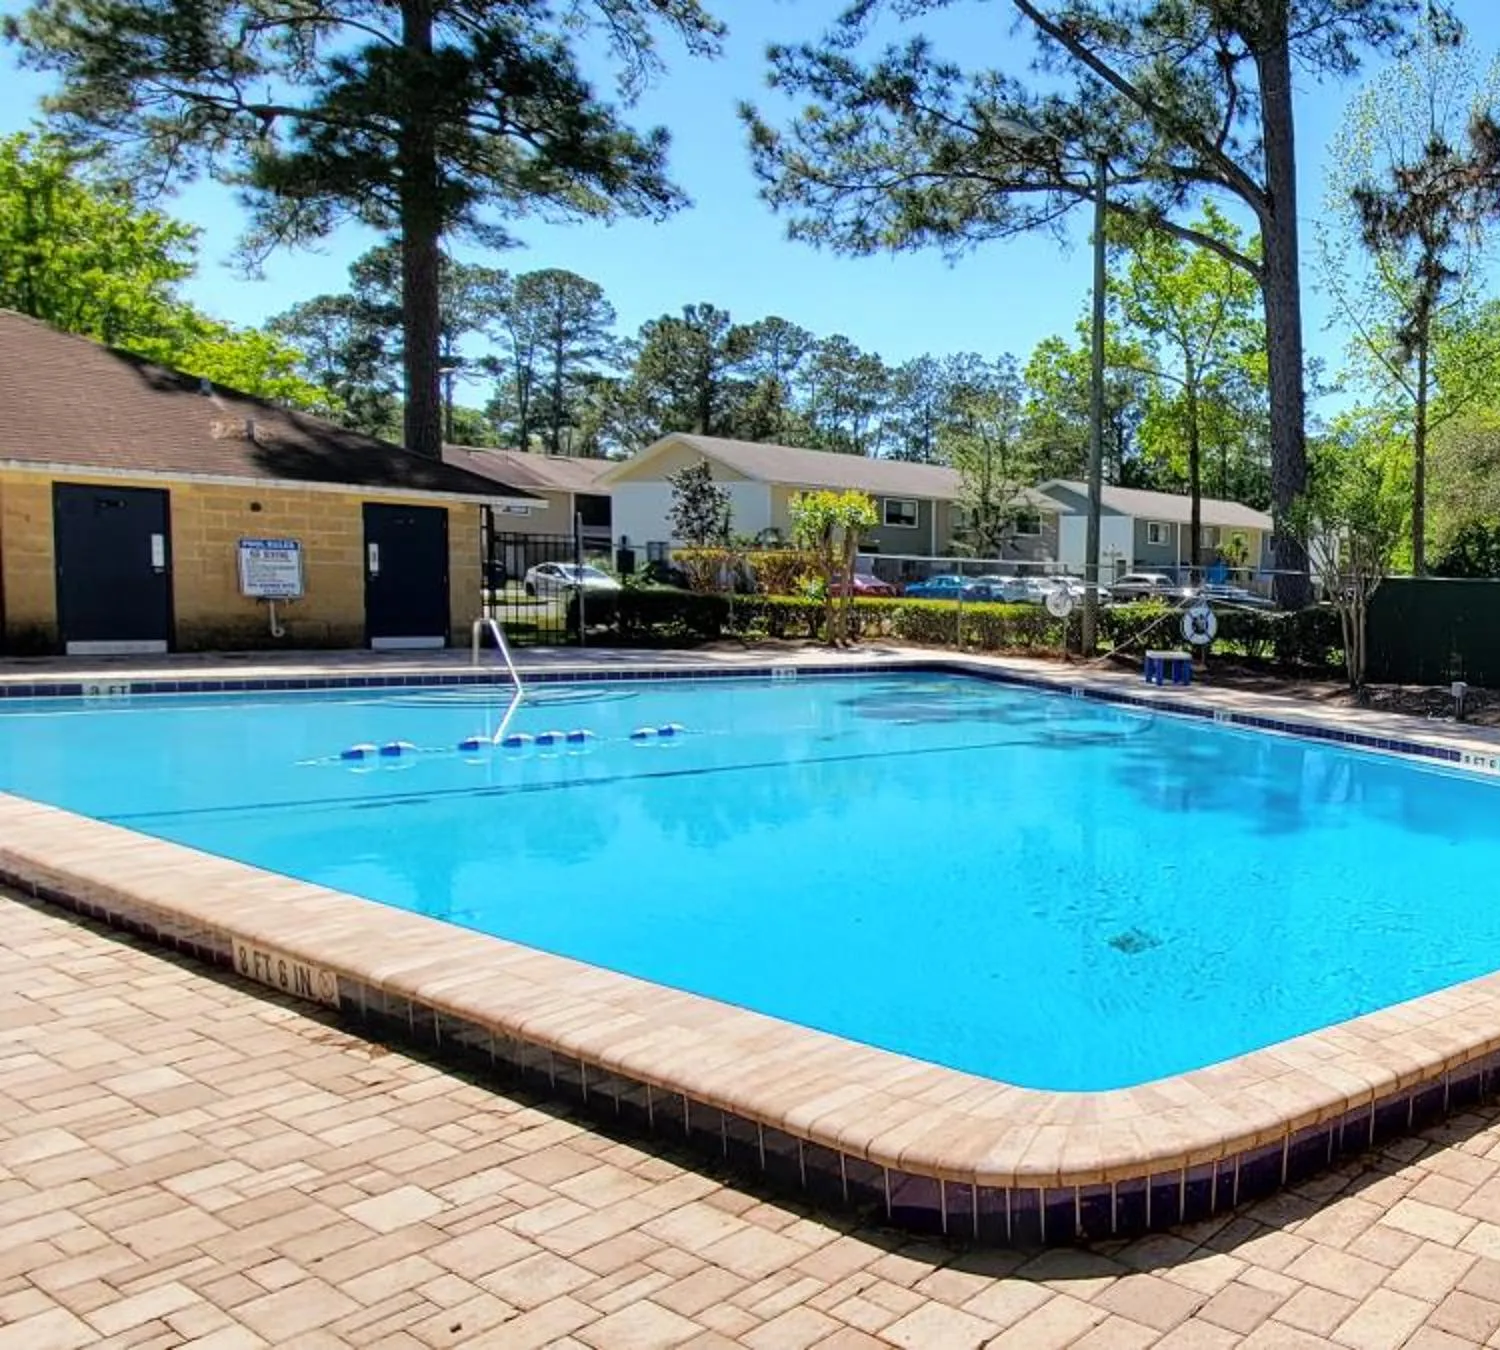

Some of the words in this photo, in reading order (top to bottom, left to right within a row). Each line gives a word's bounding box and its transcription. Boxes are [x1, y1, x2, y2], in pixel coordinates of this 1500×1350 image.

[109, 685, 128, 695] FT
[1474, 756, 1485, 767] FT
[239, 946, 248, 974] 8
[253, 950, 272, 982] FT
[293, 963, 315, 997] IN
